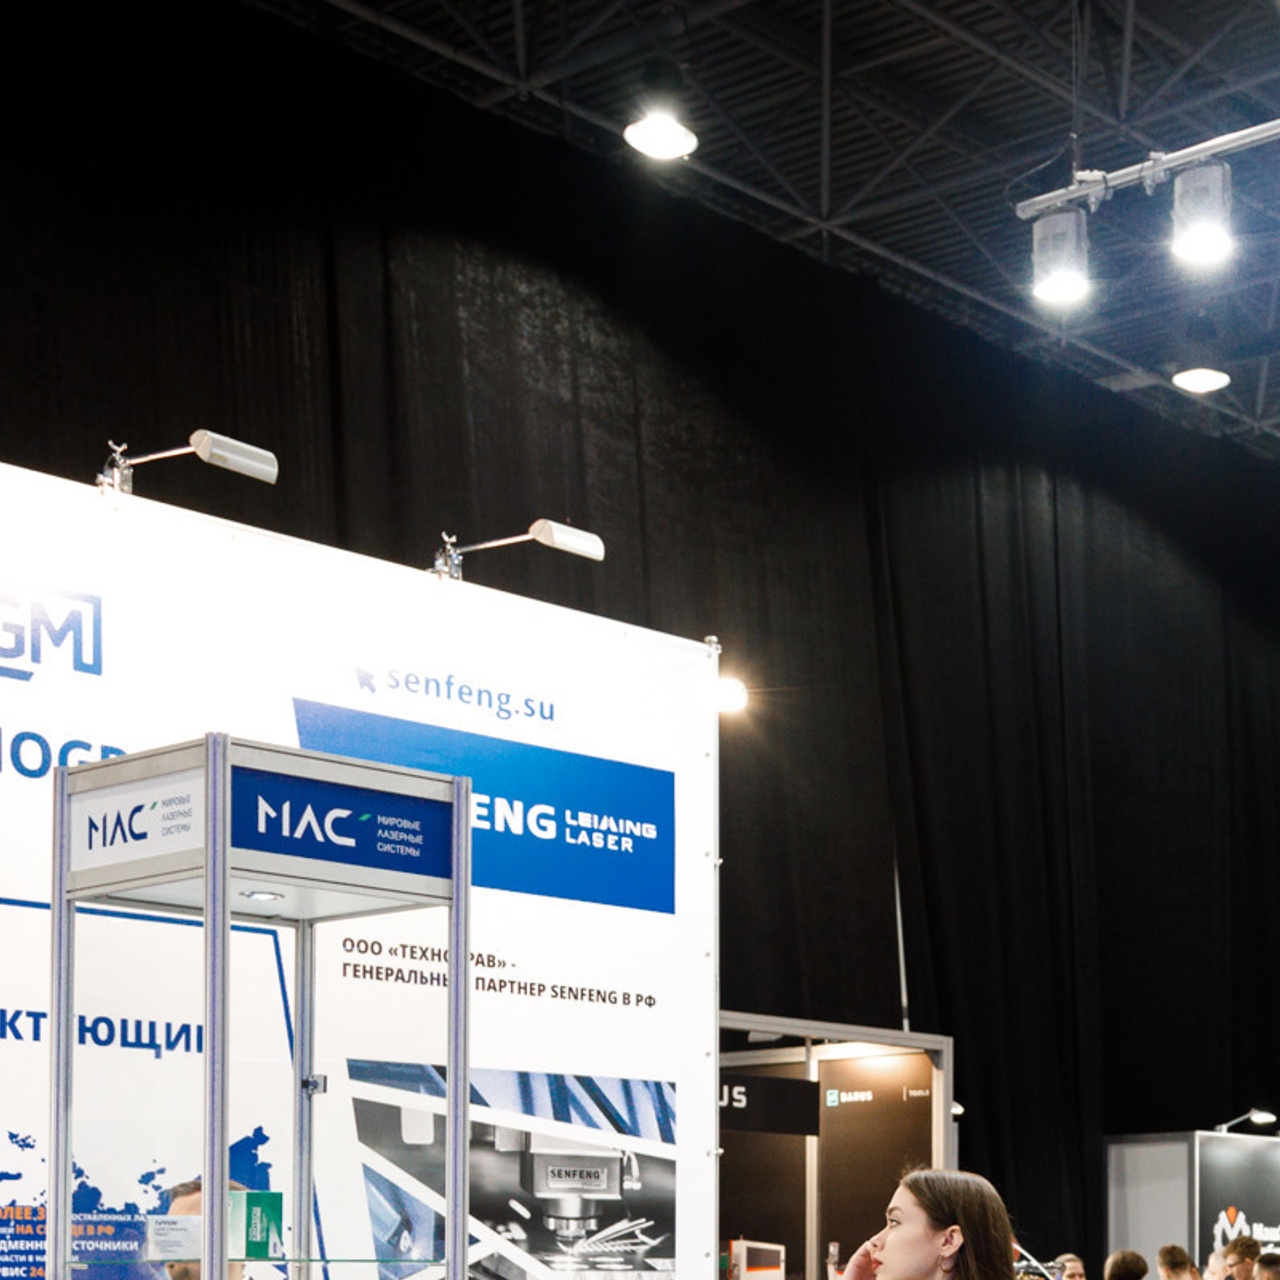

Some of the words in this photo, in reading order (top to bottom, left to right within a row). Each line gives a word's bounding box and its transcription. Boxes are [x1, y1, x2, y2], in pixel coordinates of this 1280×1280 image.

[387, 669, 555, 720] senfeng.su
[376, 815, 422, 831] МИРОВЫЕ
[376, 829, 424, 845] ЛАЗЕРНЫЕ
[565, 828, 635, 853] LASER
[376, 842, 421, 857] СИСТЕМЫ
[342, 937, 383, 956] ООО
[475, 976, 547, 997] ПАРТНЕР
[550, 985, 618, 1005] SENFENG
[635, 994, 657, 1008] РФ
[72, 1240, 139, 1251] СТОЧНИКИ
